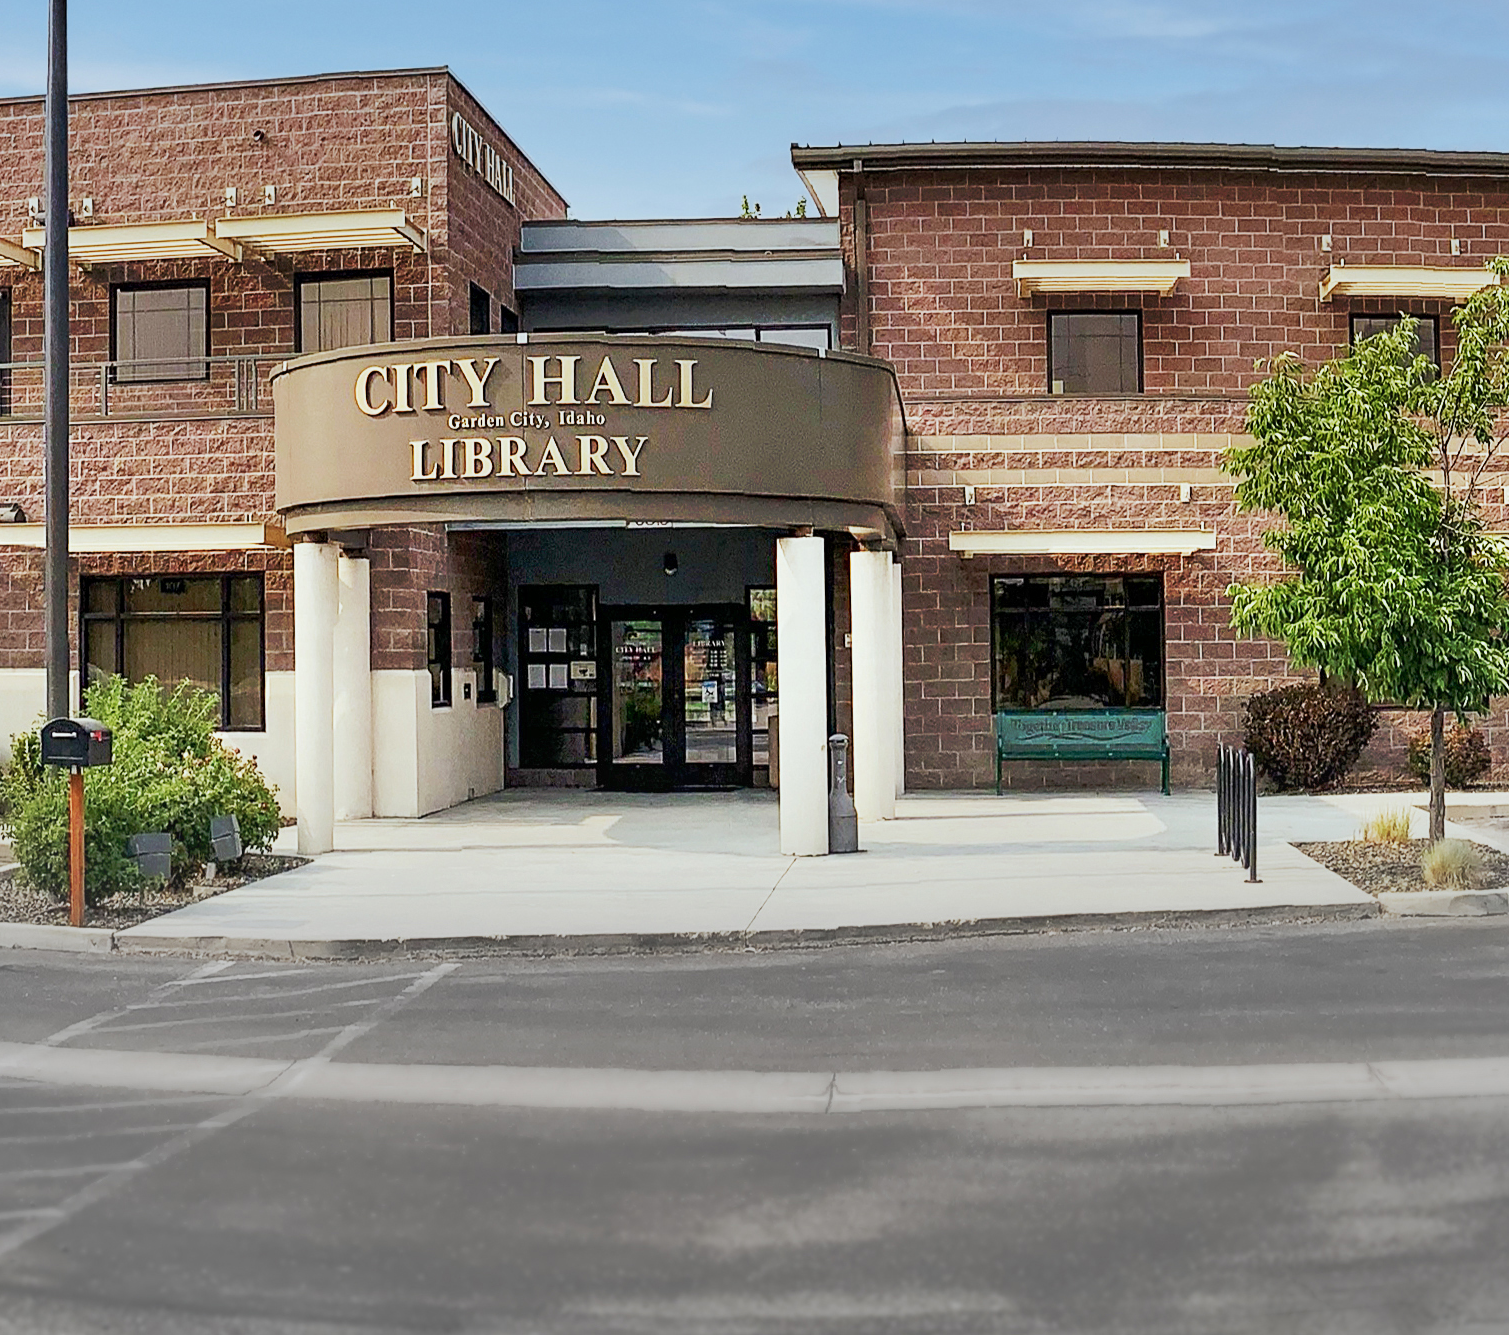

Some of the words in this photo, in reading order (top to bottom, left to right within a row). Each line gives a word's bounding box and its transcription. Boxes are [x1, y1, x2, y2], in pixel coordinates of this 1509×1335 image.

[452, 112, 483, 175] CITY
[483, 142, 516, 207] HALL
[355, 357, 500, 416] CITY
[526, 355, 713, 409] HALL
[448, 414, 504, 429] Garden
[510, 411, 551, 429] City,
[558, 410, 606, 426] Idaho
[409, 435, 648, 481] LIBRARY
